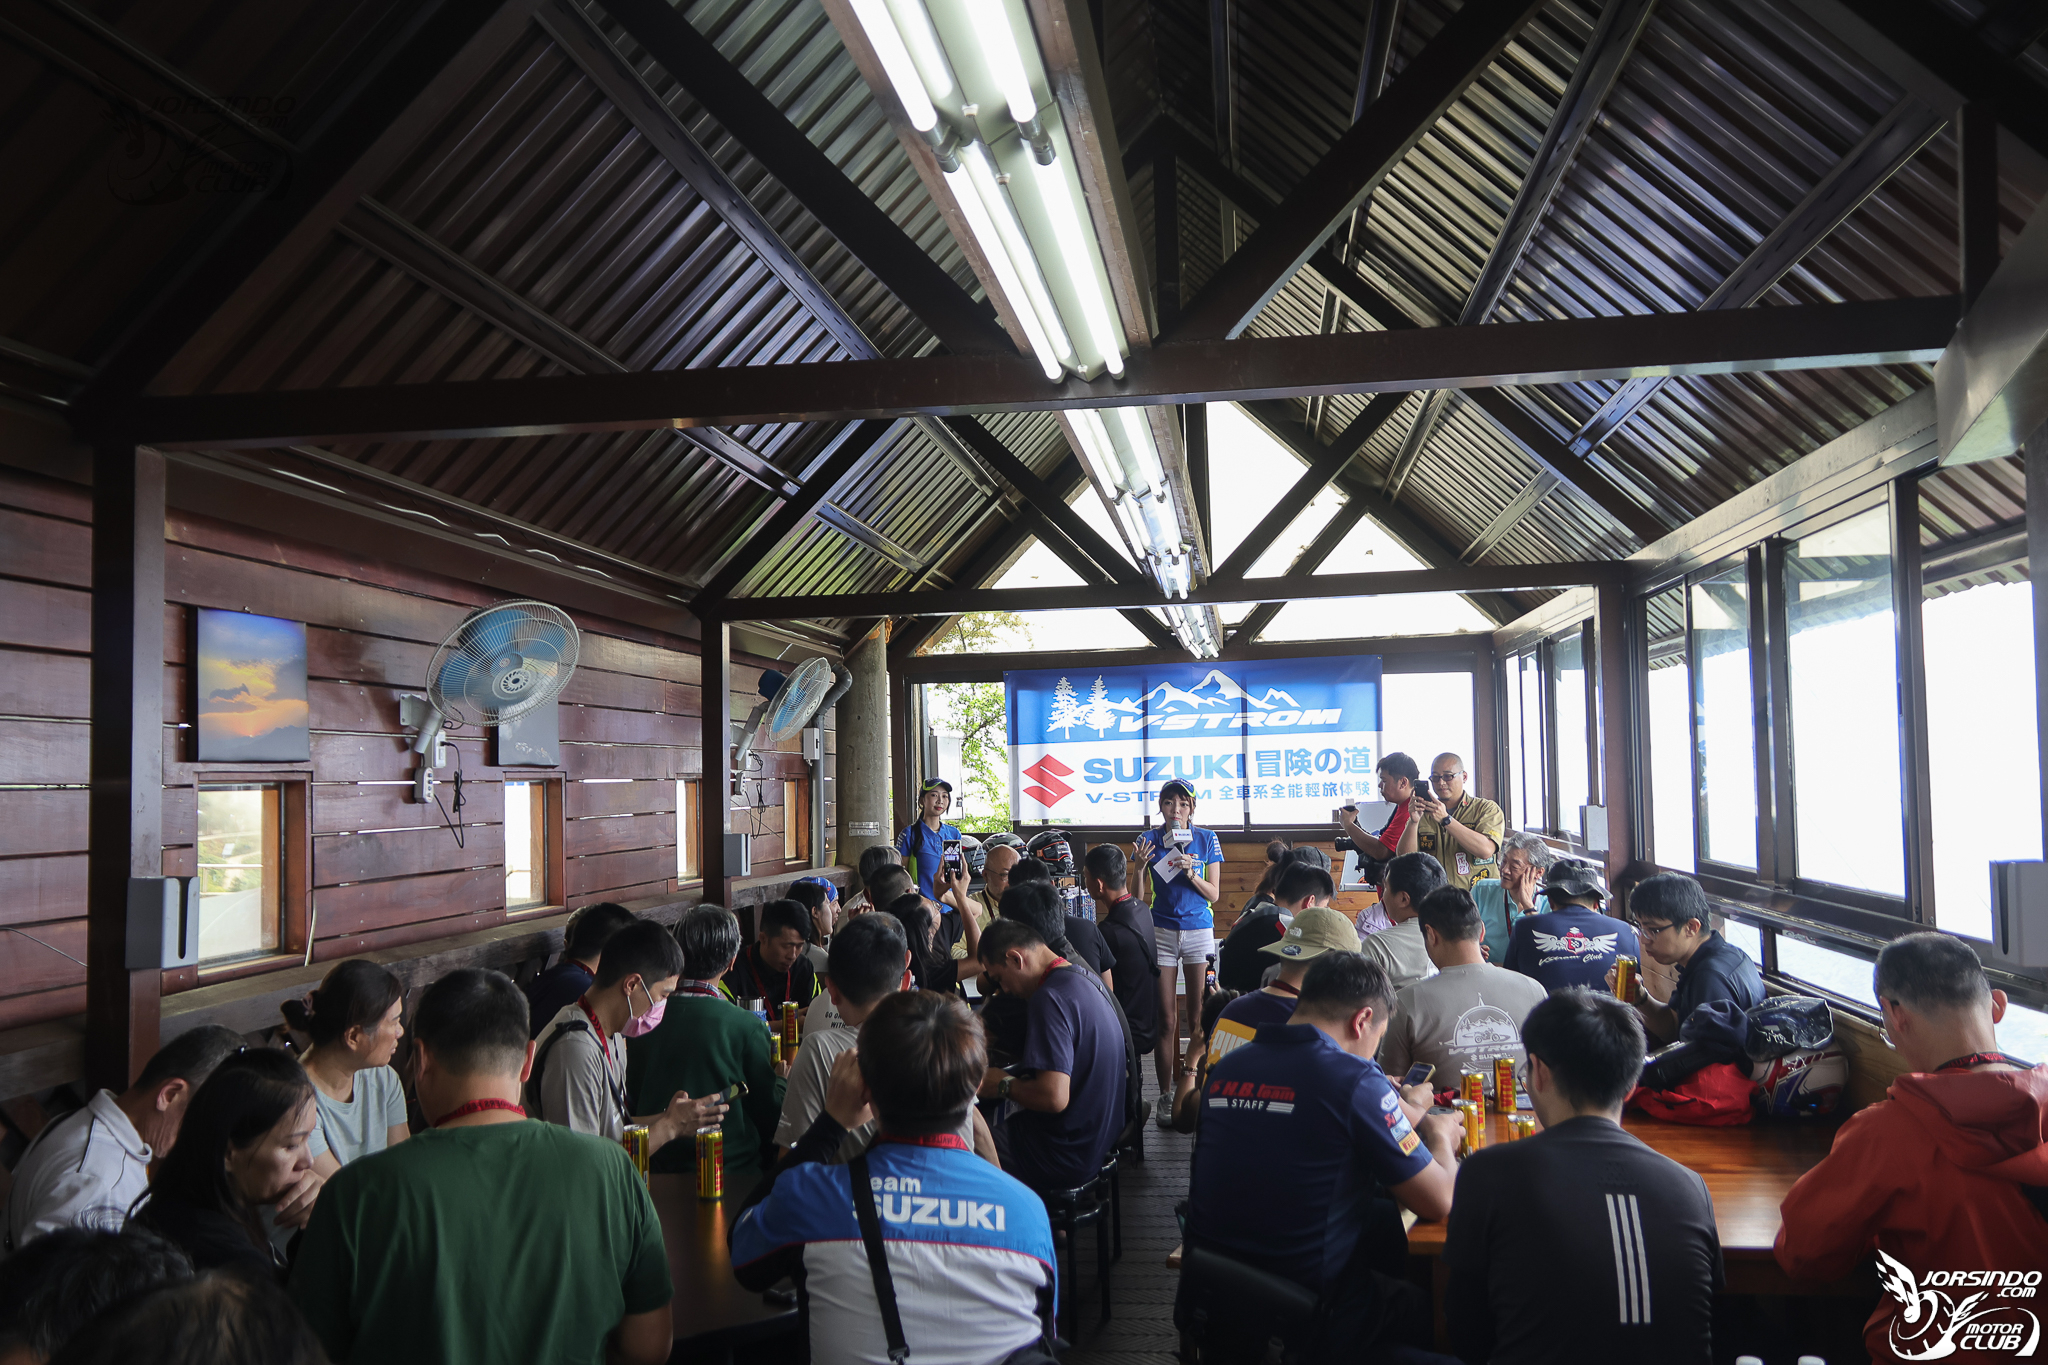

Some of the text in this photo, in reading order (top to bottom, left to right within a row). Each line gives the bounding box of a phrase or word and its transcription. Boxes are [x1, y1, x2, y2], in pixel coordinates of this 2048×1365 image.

[1118, 708, 1343, 733] V-STROM
[1083, 746, 1371, 784] SUZUKI 冒険の道
[1231, 1098, 1265, 1110] STAFF
[868, 1176, 921, 1193] eam
